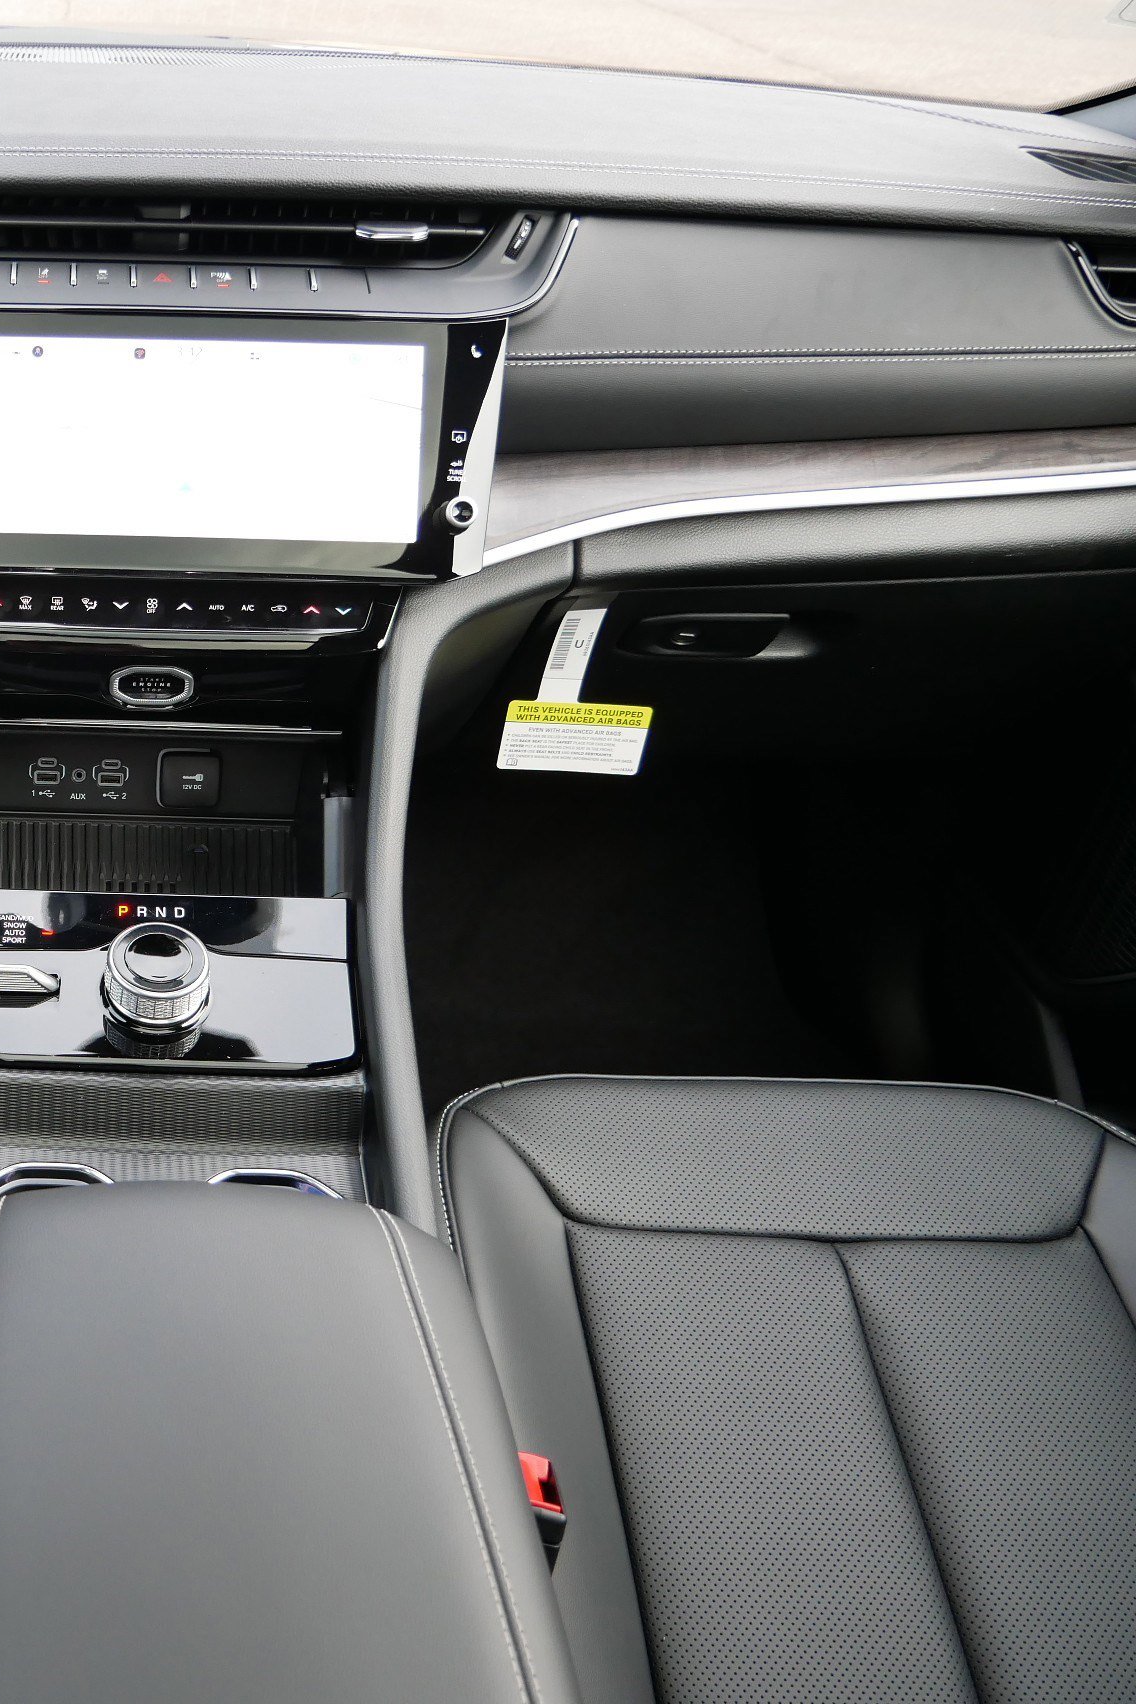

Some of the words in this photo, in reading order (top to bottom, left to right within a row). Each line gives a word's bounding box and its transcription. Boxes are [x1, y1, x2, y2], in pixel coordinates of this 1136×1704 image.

[241, 604, 255, 612] A/C
[542, 706, 581, 715] VEHICLE
[596, 709, 644, 718] EQUIPPED
[542, 715, 595, 724] ADVANCED
[598, 717, 614, 725] AIR
[616, 718, 642, 726] BAGS
[122, 792, 127, 800] 2
[118, 906, 128, 917] P
[137, 906, 147, 918] R
[156, 906, 166, 918] N
[174, 907, 185, 919] D
